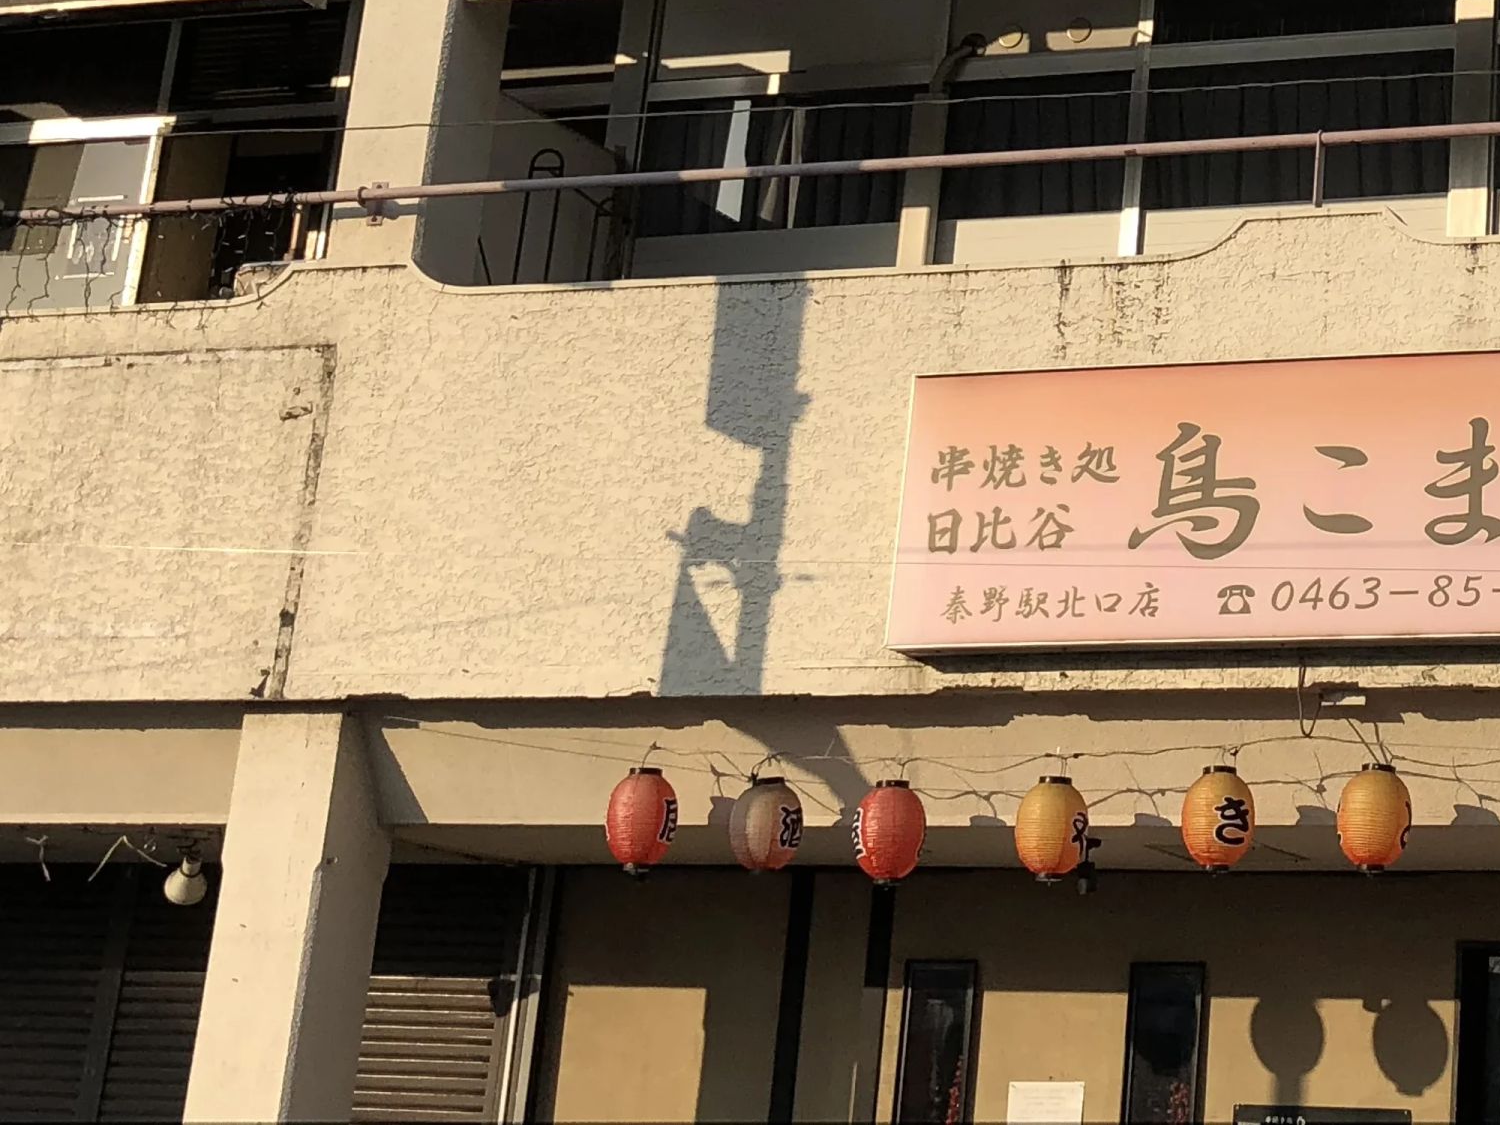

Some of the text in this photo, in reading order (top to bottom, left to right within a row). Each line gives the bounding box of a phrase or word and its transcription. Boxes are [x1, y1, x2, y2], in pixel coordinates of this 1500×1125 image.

[930, 441, 1121, 492] 串焼き処
[926, 502, 1074, 555] 日比谷
[941, 581, 1161, 625] 秦野駅北口店
[1214, 796, 1250, 846] き
